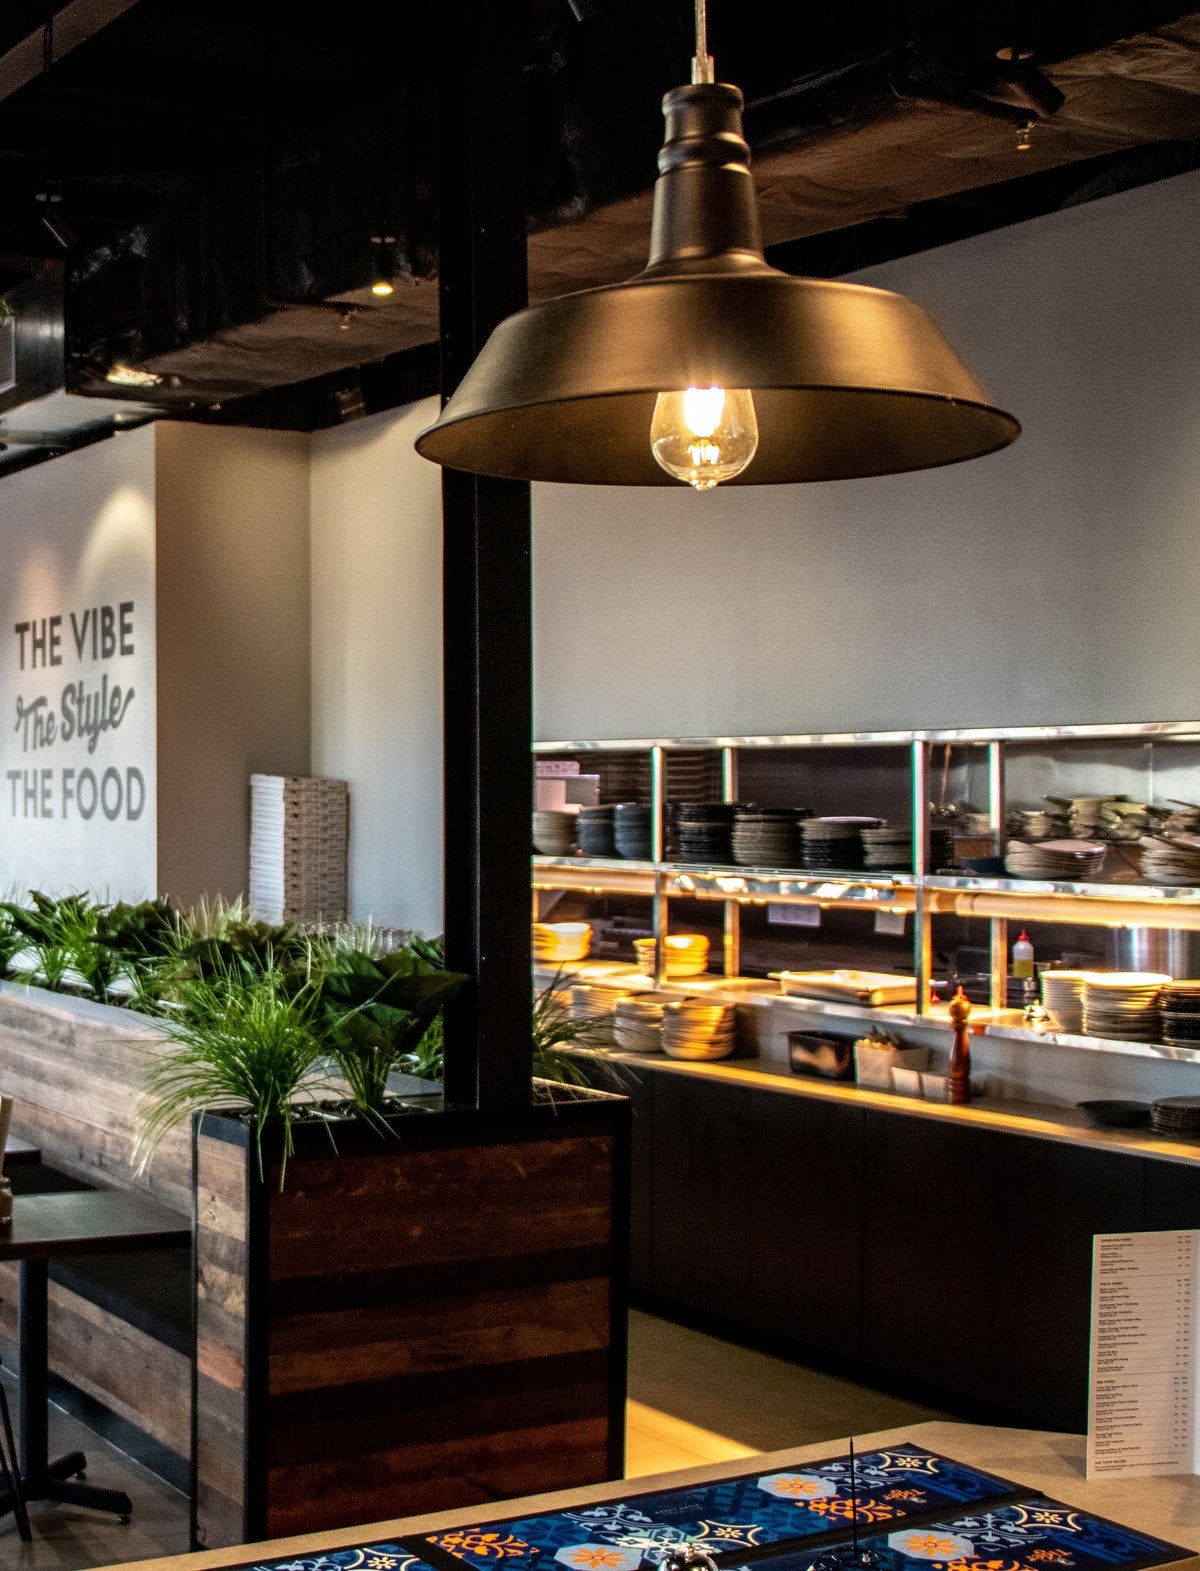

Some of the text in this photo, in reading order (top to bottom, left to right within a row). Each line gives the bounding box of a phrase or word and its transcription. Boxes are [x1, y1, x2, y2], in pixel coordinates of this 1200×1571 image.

[15, 601, 135, 670] THE VIBE
[15, 673, 136, 755] The Style
[7, 766, 146, 821] THE FOOD
